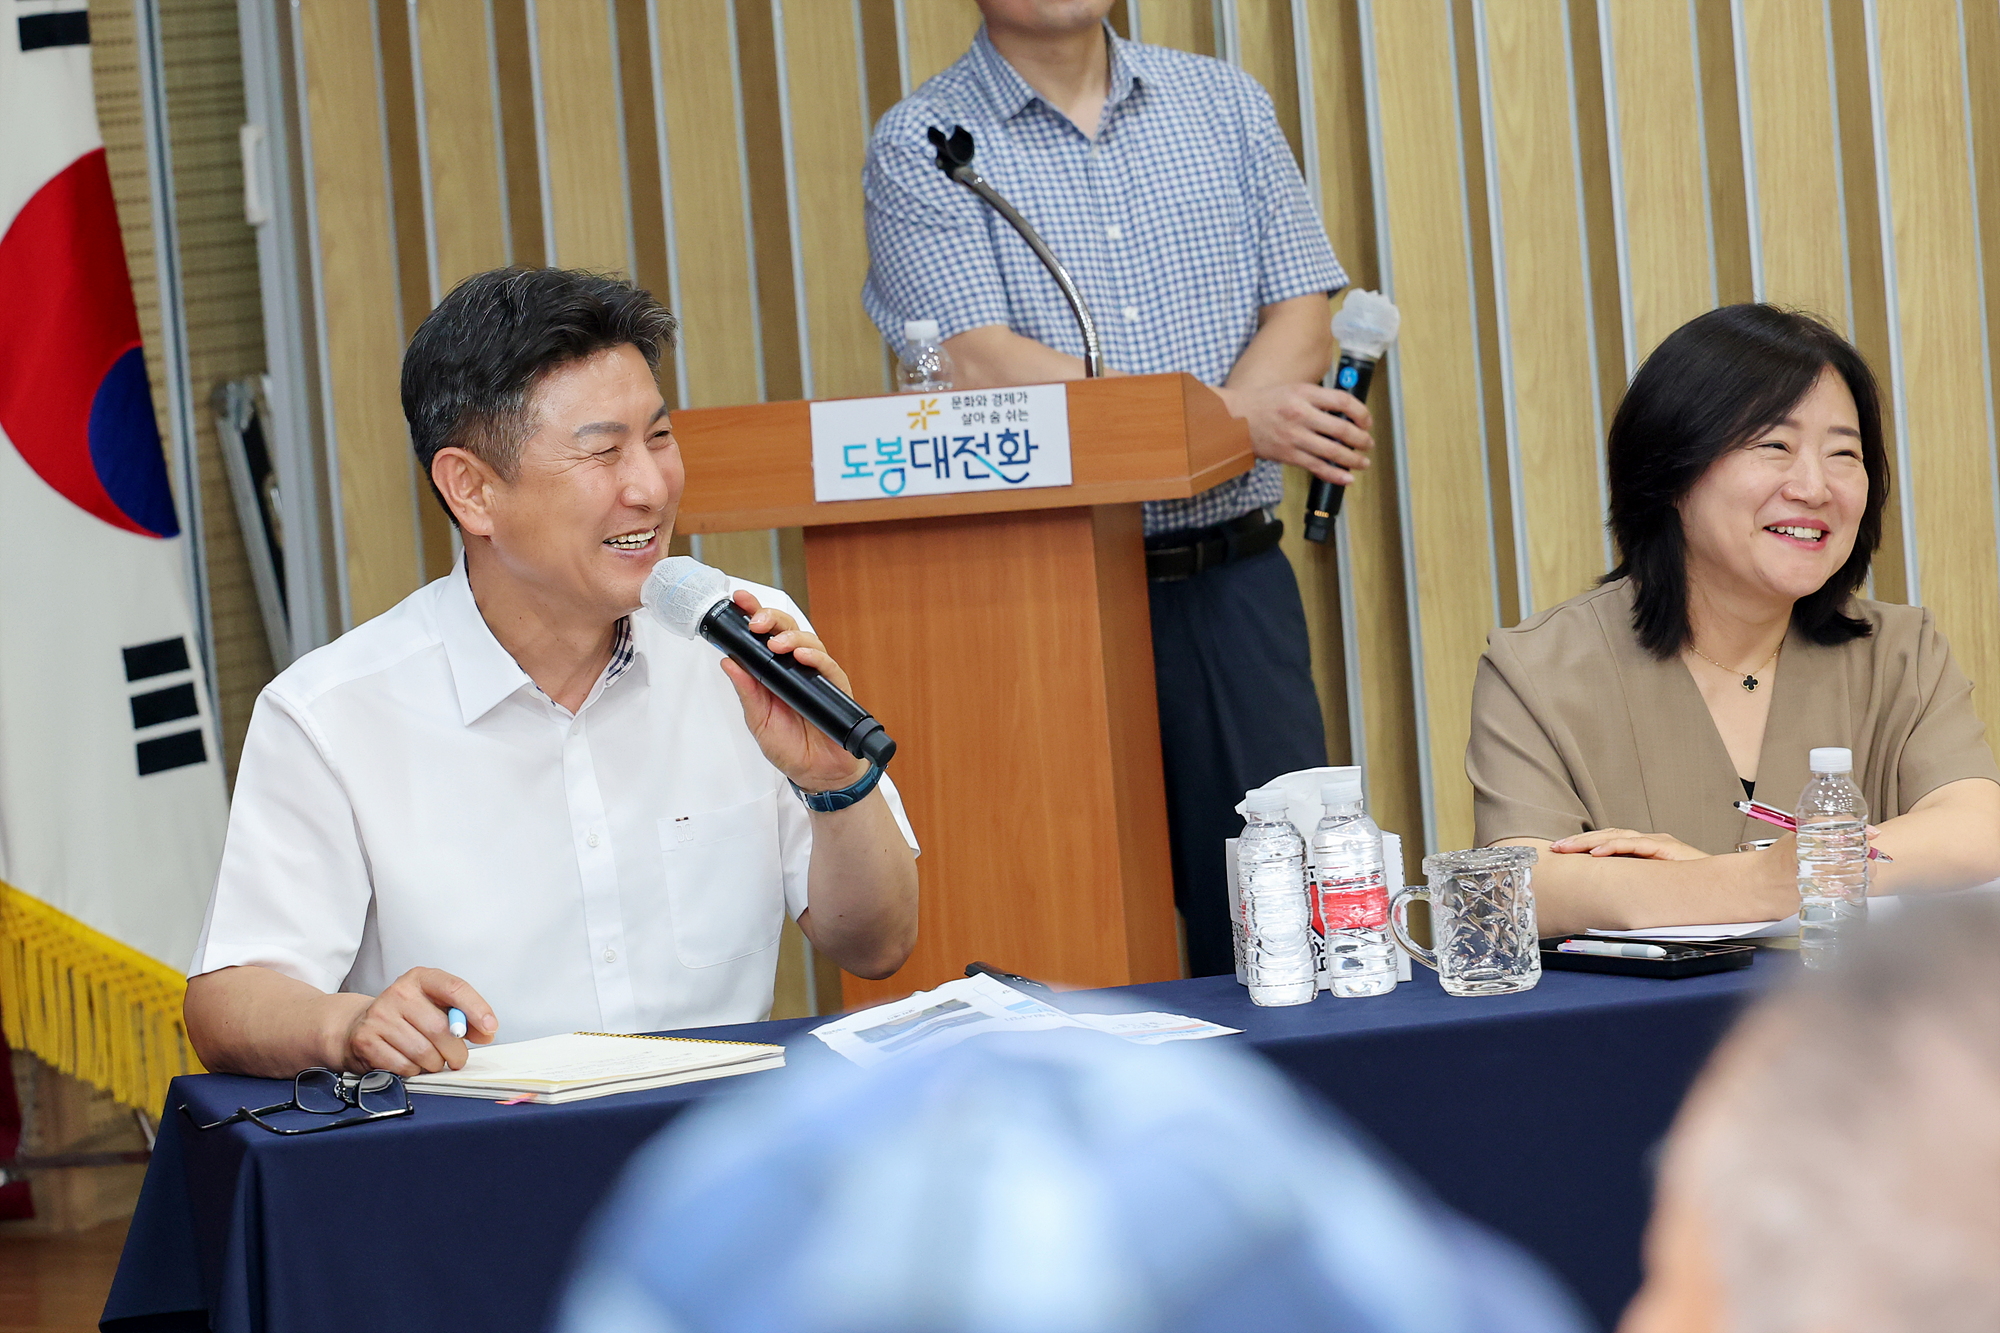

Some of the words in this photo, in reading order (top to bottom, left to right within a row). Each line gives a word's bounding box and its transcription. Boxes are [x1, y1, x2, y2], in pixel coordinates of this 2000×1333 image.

[951, 394, 987, 410] 문화와
[992, 391, 1028, 407] 경제가
[962, 411, 985, 426] 살아
[990, 410, 1000, 424] 숨
[1005, 408, 1029, 422] 쉬는
